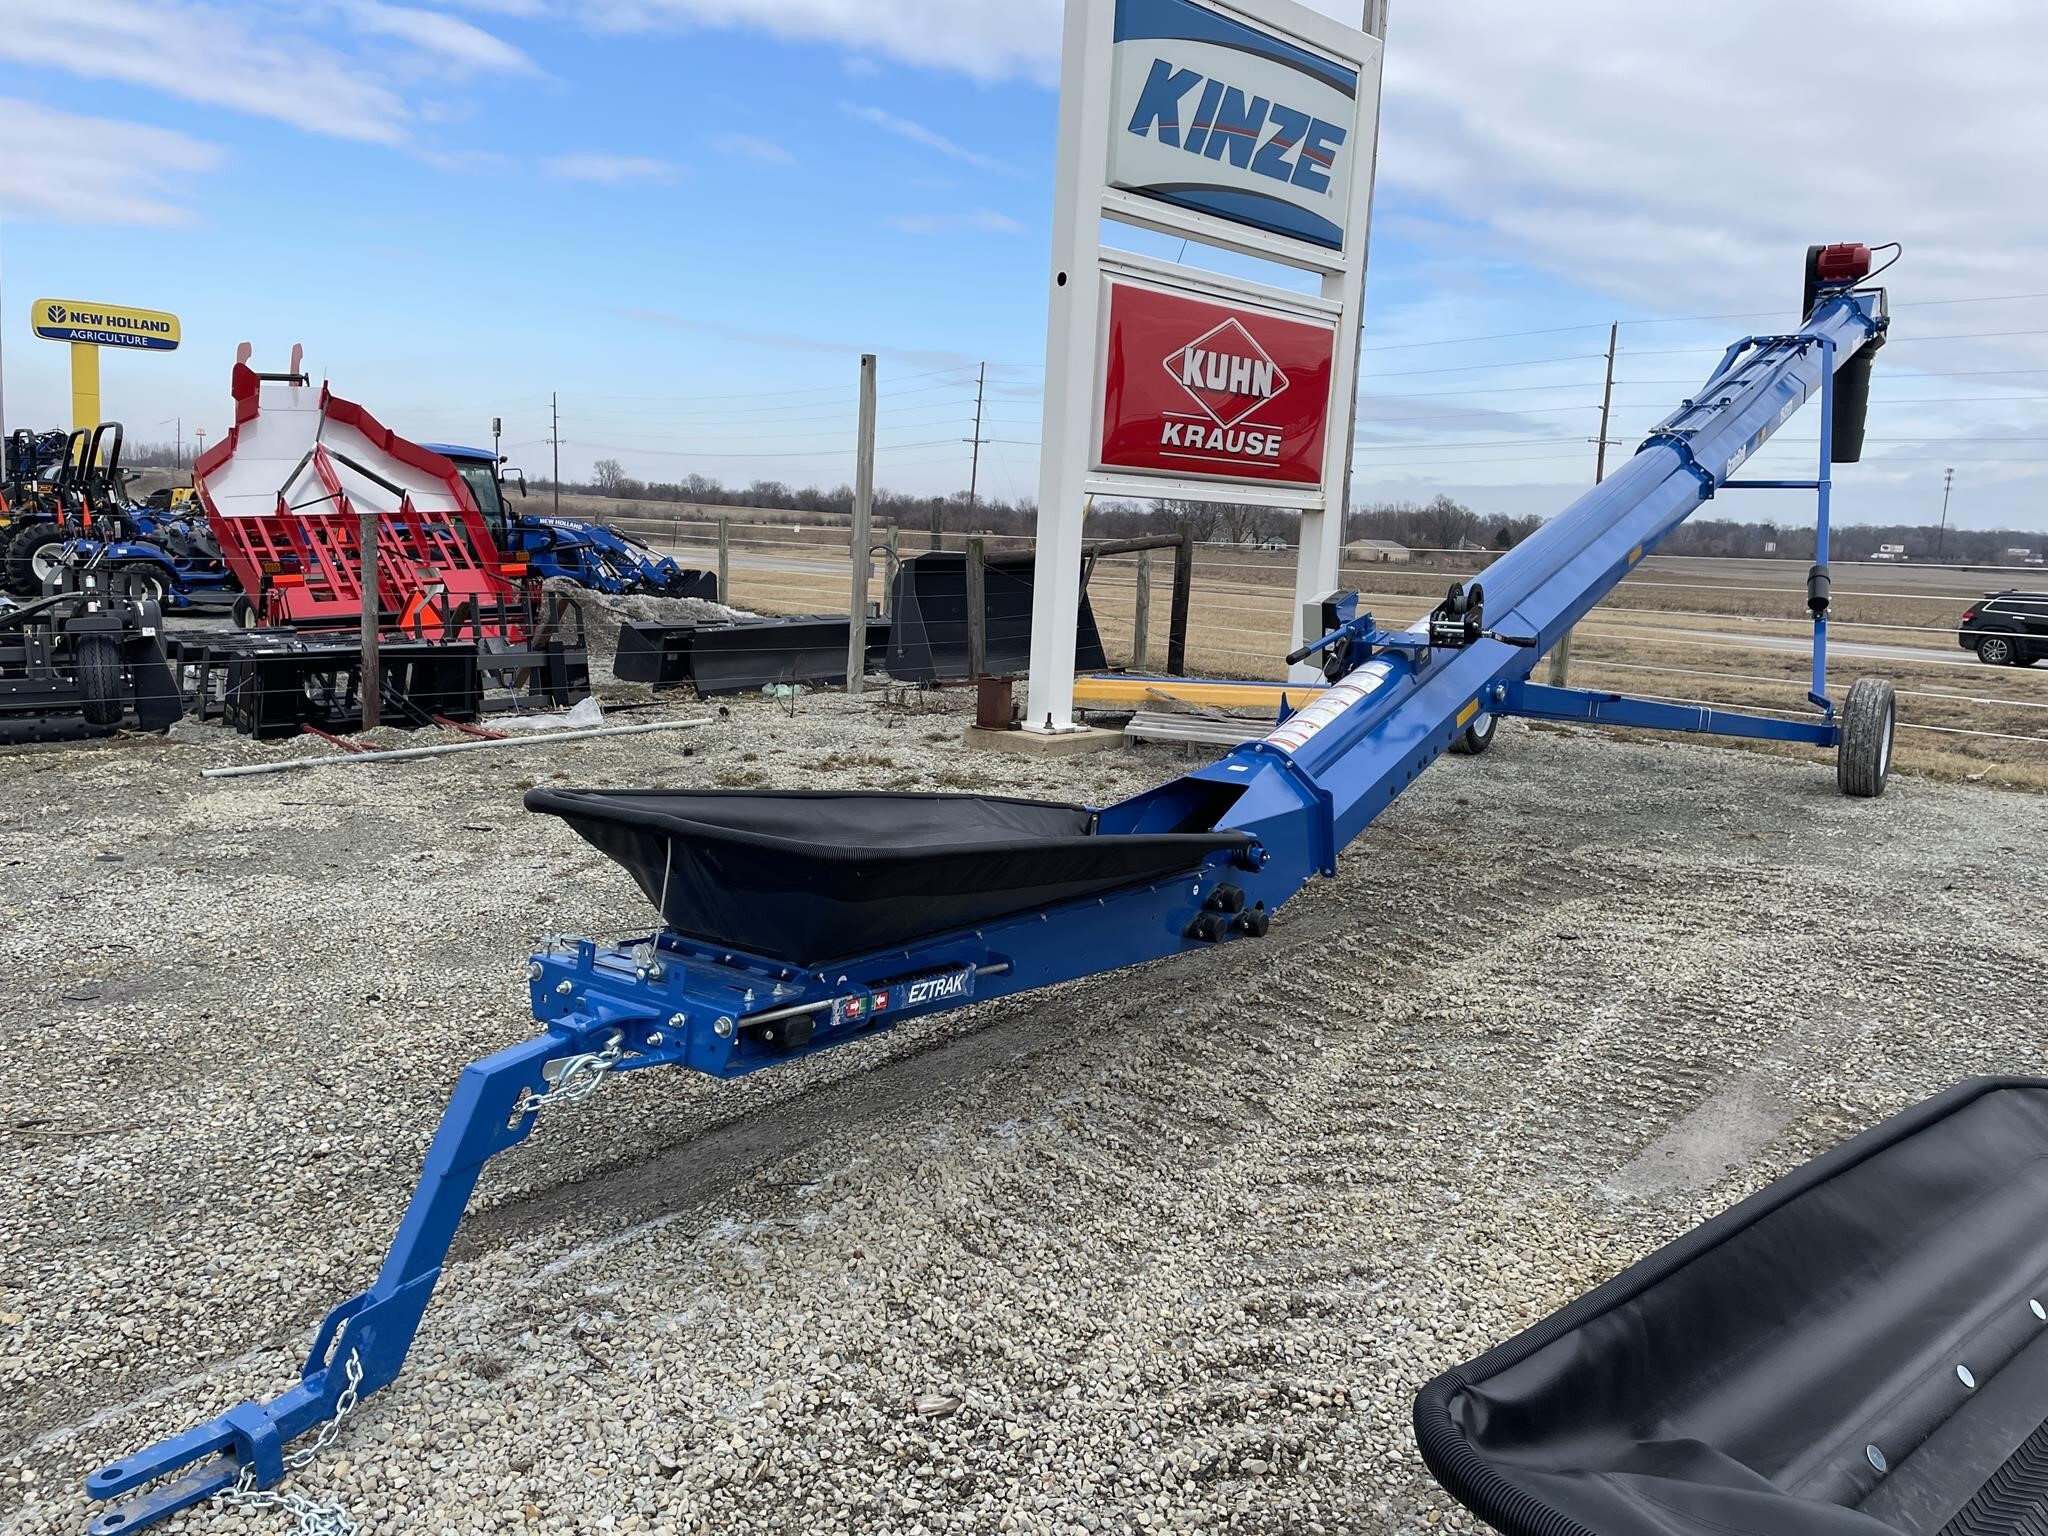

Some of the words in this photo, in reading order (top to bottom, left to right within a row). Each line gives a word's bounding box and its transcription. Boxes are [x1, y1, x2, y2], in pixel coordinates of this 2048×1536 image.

[1127, 57, 1347, 194] KINZE
[69, 329, 149, 346] AGRICULTURE
[70, 311, 103, 326] NEW
[106, 315, 170, 333] HOLLAND
[1182, 347, 1274, 399] KUHN
[1160, 420, 1283, 458] KRAUSE
[555, 520, 583, 530] HOLLAND
[908, 973, 965, 1004] EZTRAK
